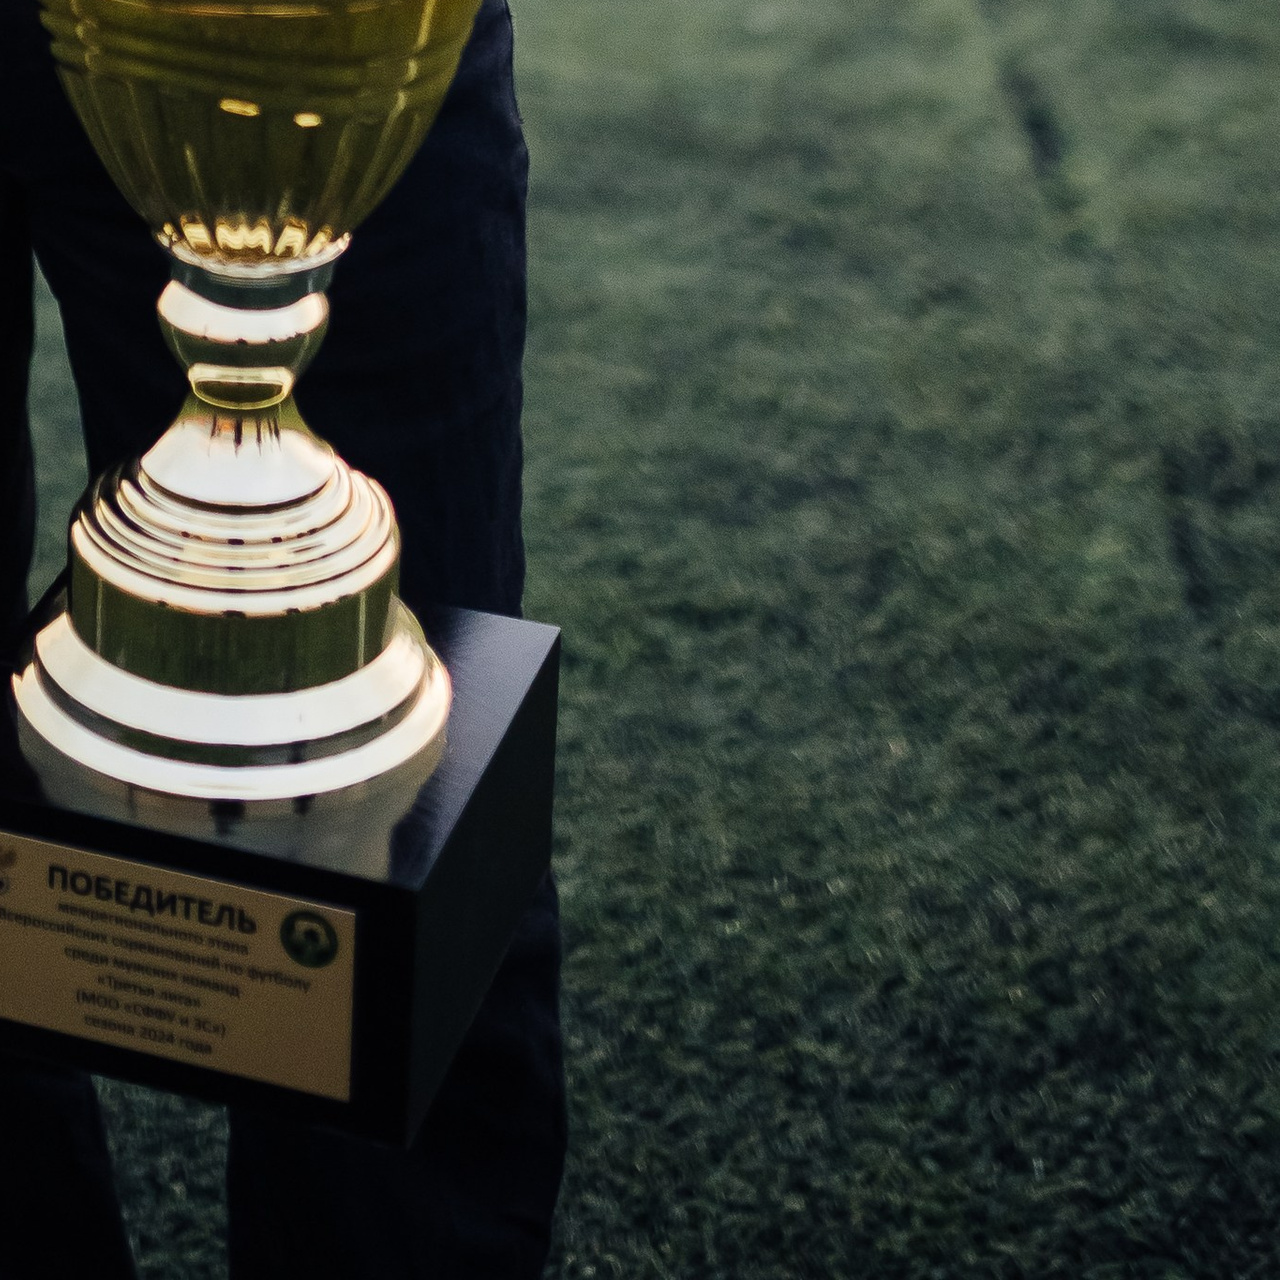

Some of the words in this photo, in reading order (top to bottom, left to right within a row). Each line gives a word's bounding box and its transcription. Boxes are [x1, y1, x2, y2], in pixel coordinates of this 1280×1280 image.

[48, 864, 258, 936] ПОБЕДИТЕЛЬ
[64, 947, 108, 966] среди
[224, 961, 243, 976] по
[247, 966, 311, 994] футболу
[77, 989, 120, 1010] (МОО
[179, 1016, 189, 1028] и
[139, 1026, 175, 1044] 2024
